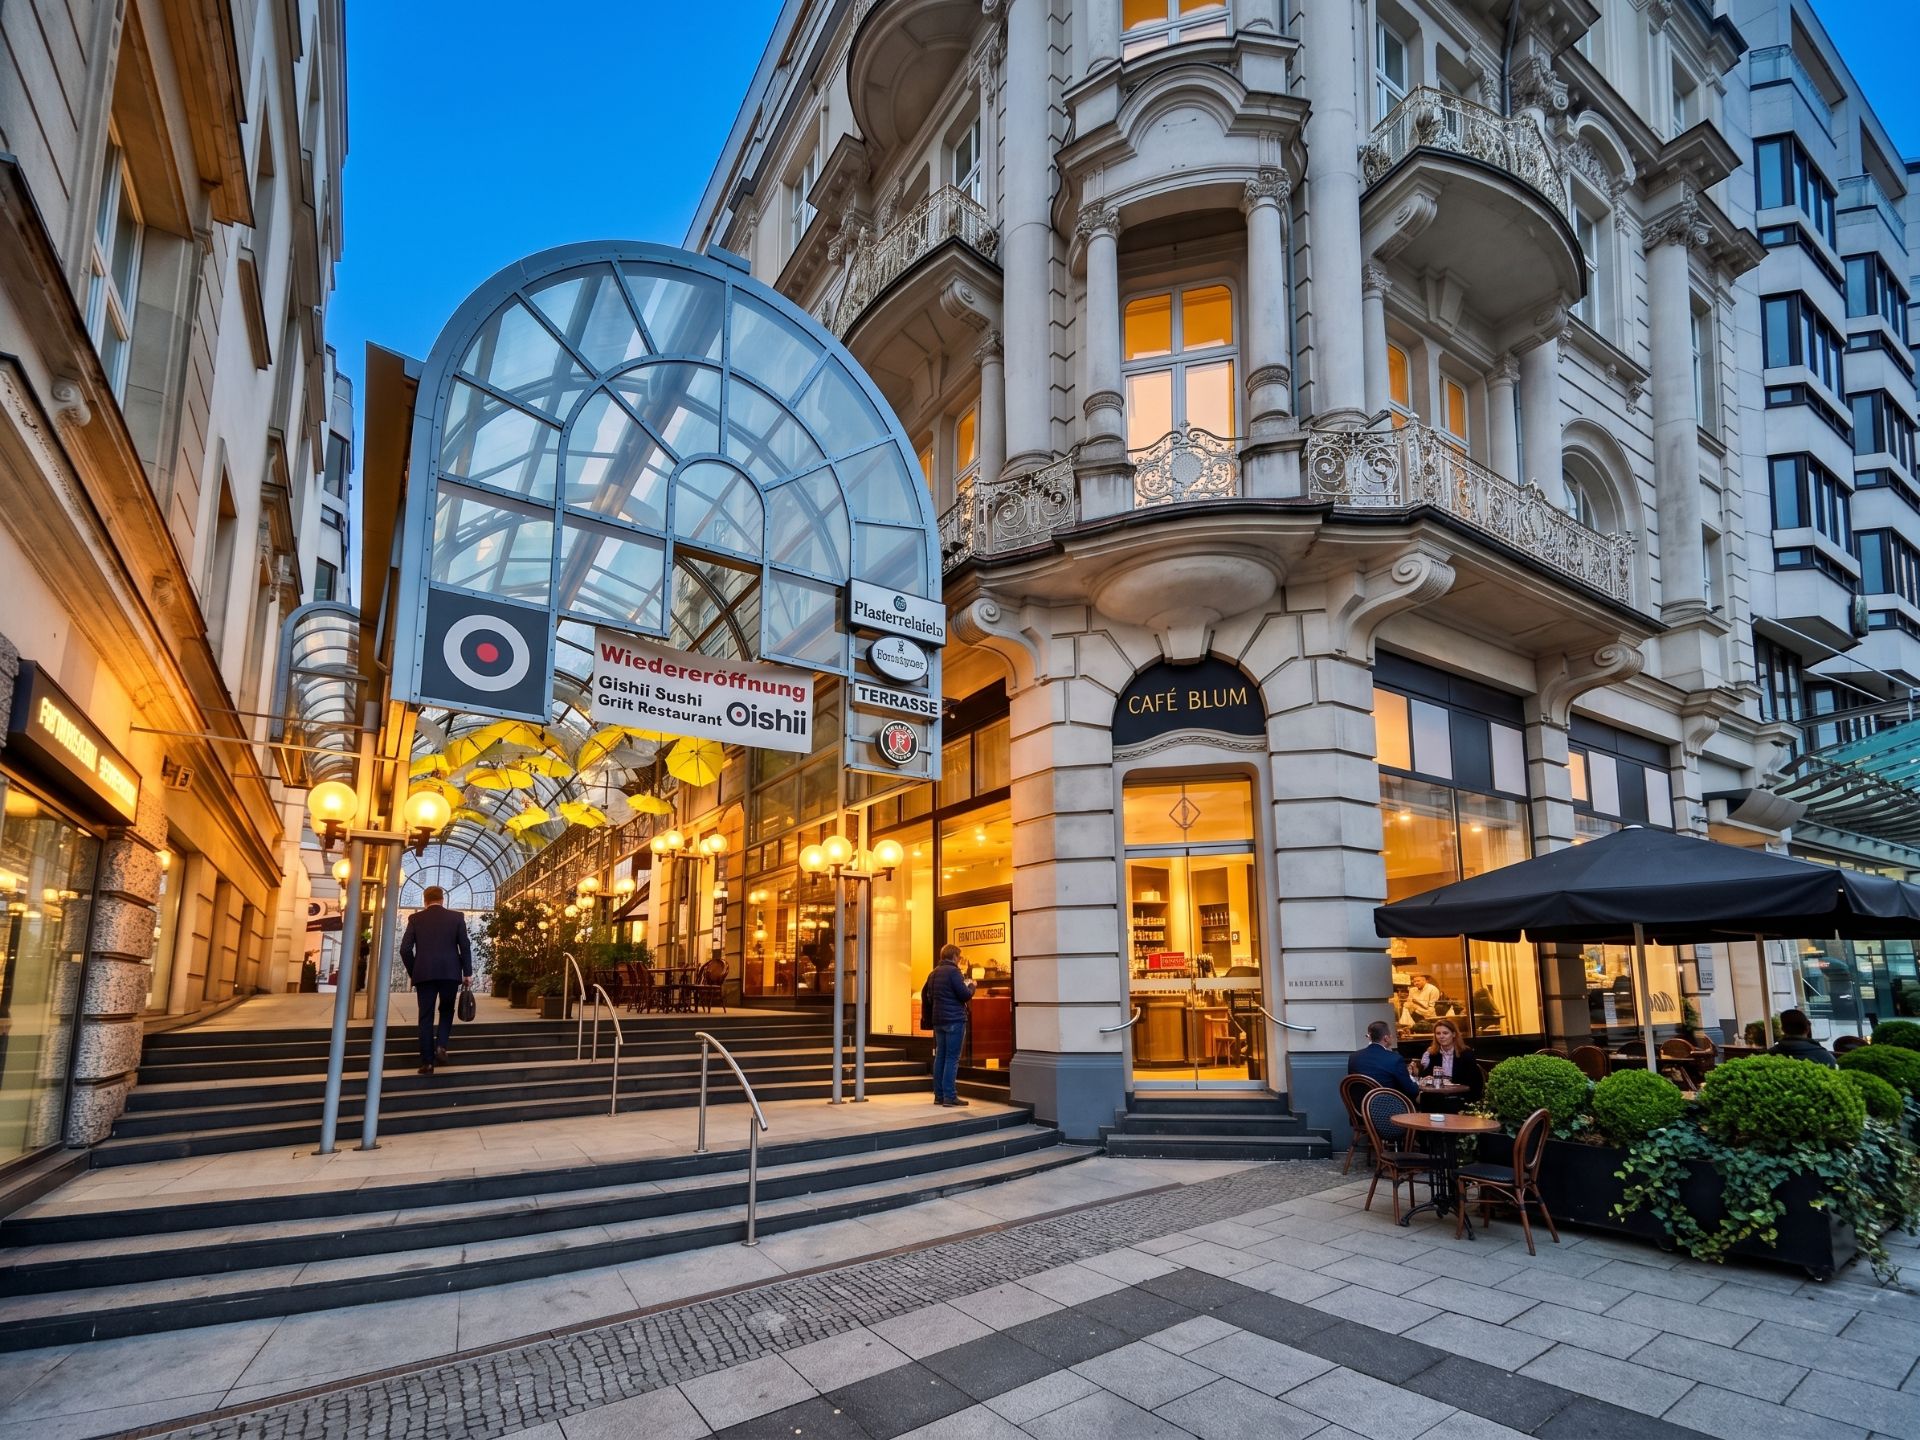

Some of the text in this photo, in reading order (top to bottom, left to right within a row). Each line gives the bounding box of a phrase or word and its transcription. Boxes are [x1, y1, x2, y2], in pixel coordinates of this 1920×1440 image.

[601, 643, 806, 703] Wiedereröffnung
[598, 675, 702, 707] Gishii Sushi
[858, 686, 938, 715] TERRASSE
[1128, 686, 1248, 714] CAFÉ BLUM
[638, 701, 722, 727] Restaurant
[726, 701, 807, 735] Oishii
